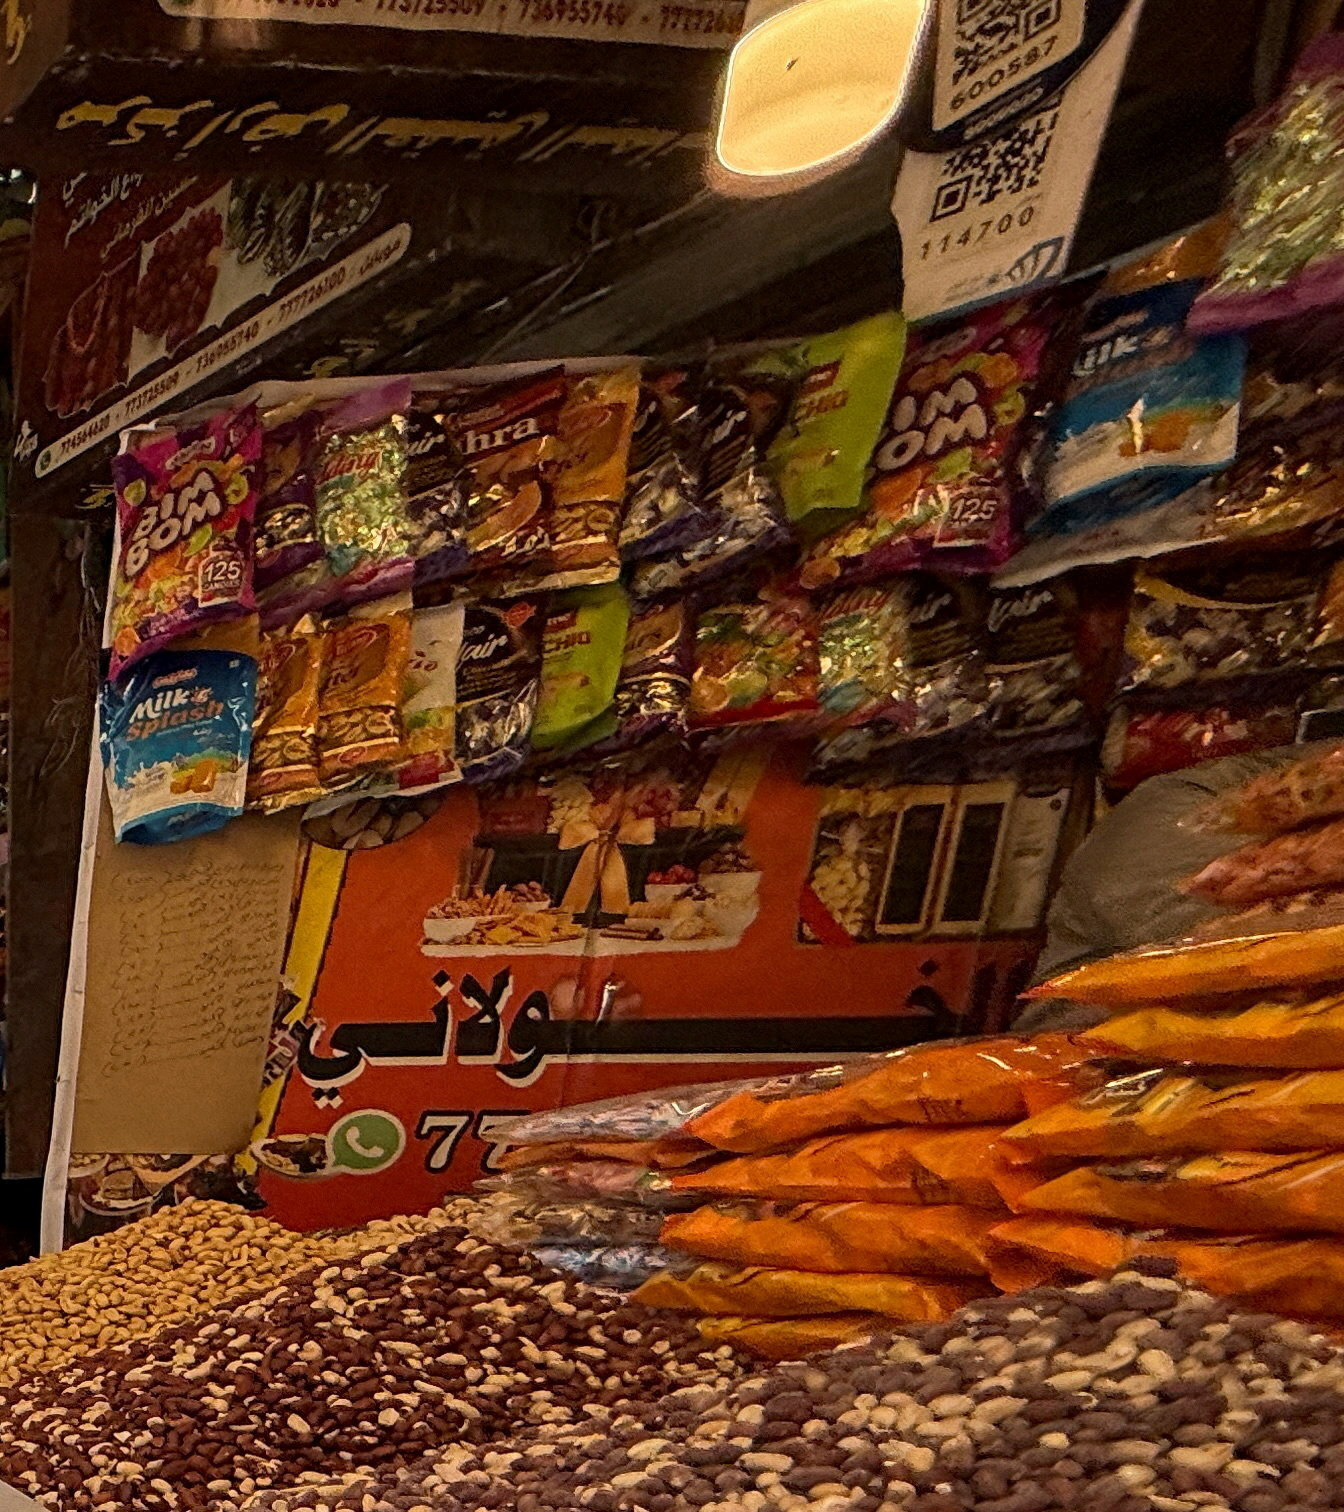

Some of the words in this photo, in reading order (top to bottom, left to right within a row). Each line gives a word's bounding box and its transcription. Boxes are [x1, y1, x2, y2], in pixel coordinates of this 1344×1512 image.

[949, 35, 1059, 112] 600587
[920, 205, 1035, 262] 114700
[125, 490, 224, 578] BOM
[132, 470, 217, 542] BIM
[950, 497, 997, 524] 125
[204, 560, 242, 582] 125
[129, 686, 191, 724] Milk
